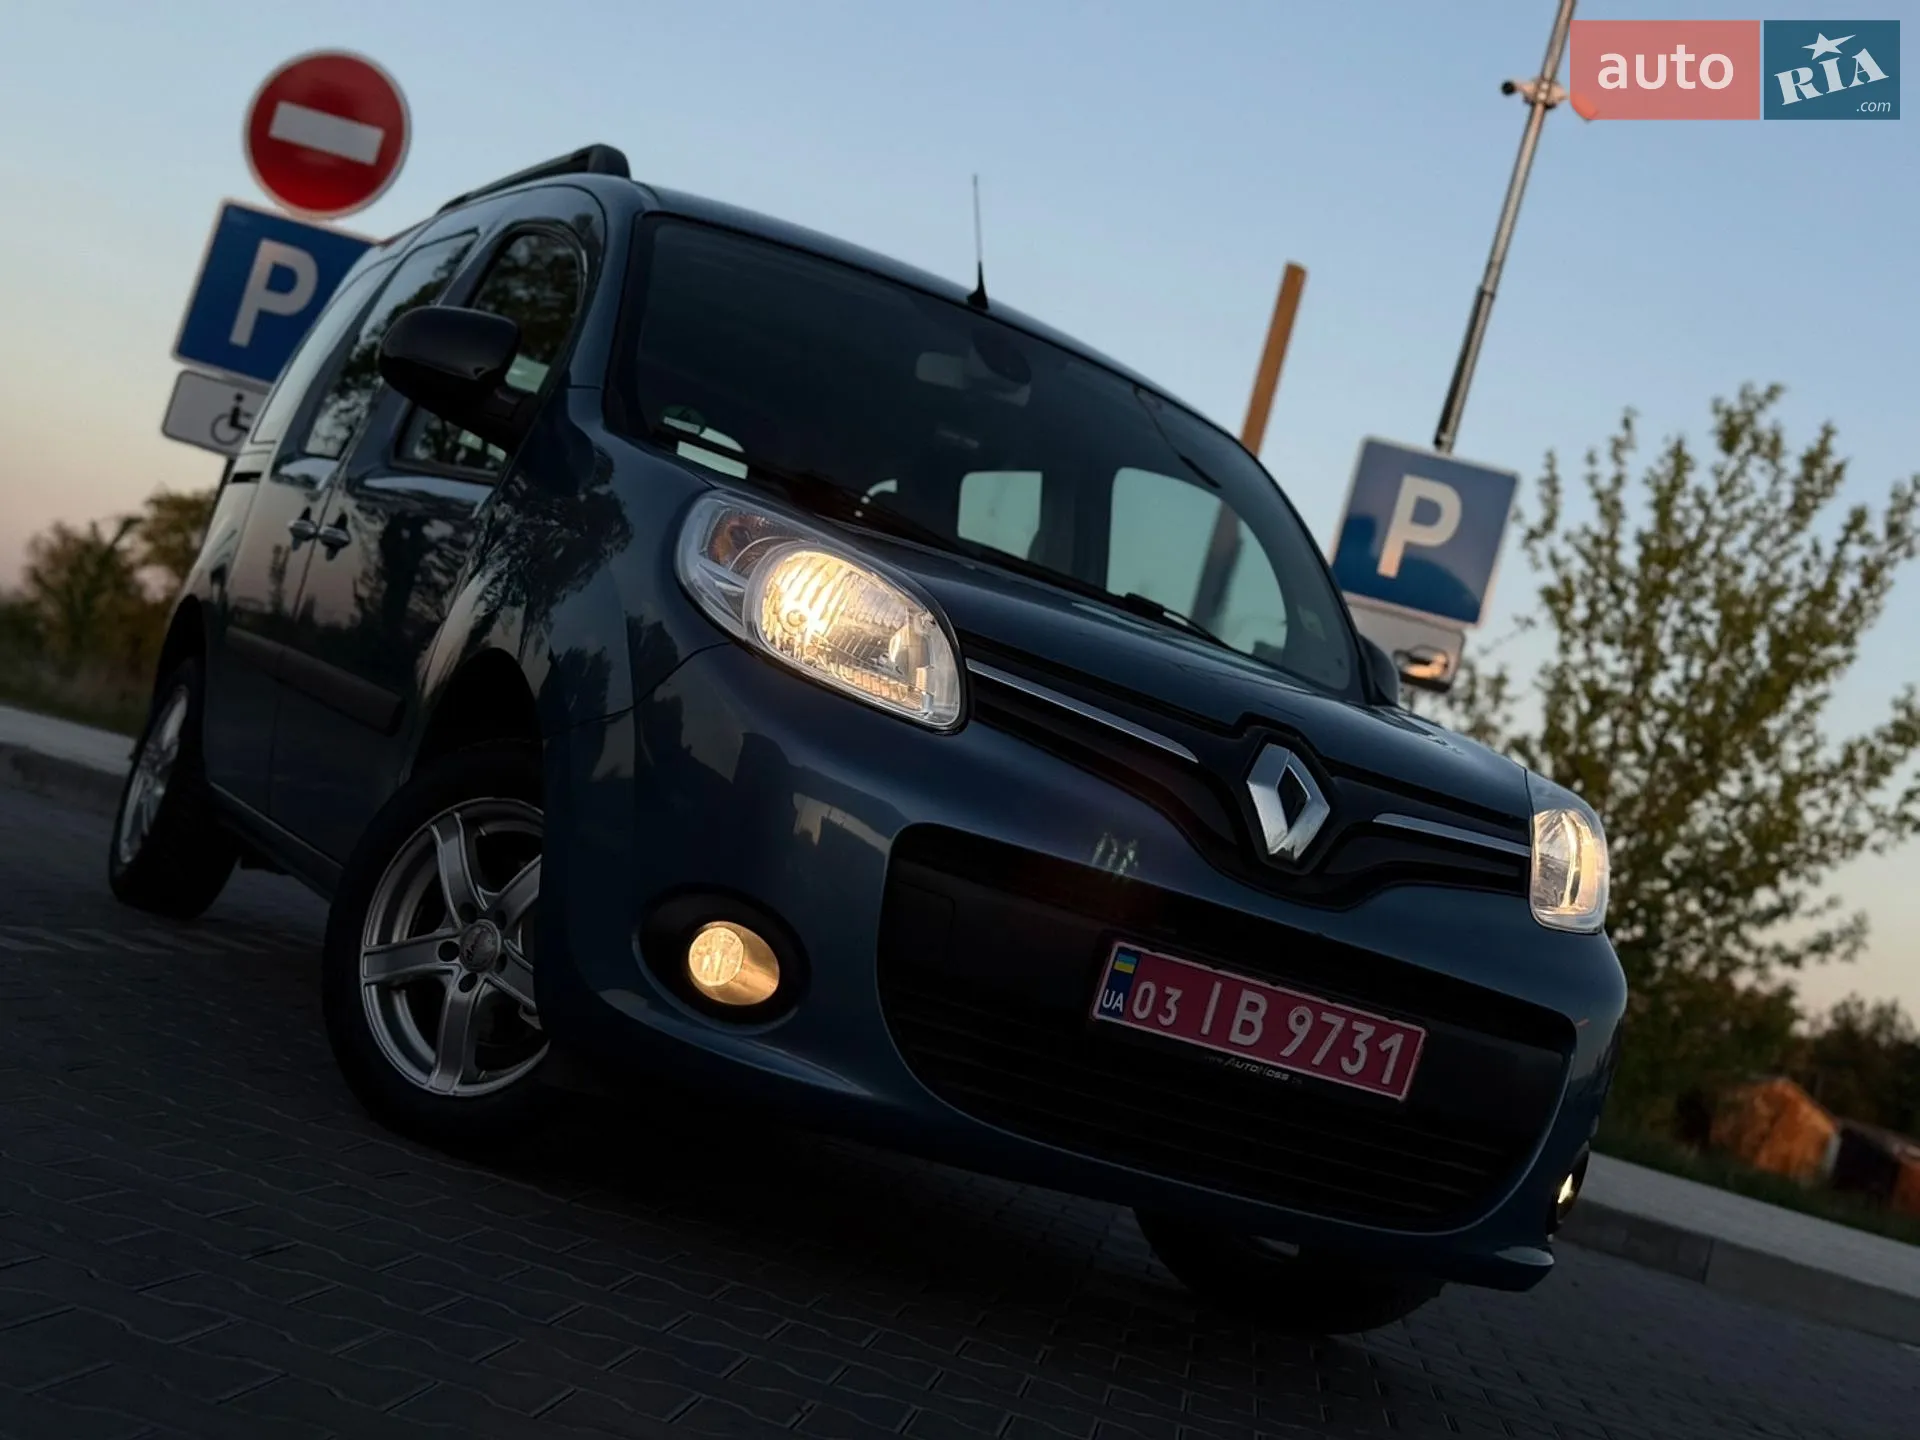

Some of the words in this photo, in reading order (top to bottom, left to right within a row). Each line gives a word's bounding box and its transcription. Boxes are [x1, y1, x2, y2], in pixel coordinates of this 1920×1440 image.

[228, 237, 318, 348] P
[1377, 474, 1463, 578] P
[1101, 988, 1125, 1013] UA
[1131, 980, 1182, 1026] 03
[1279, 1005, 1405, 1086] 9731
